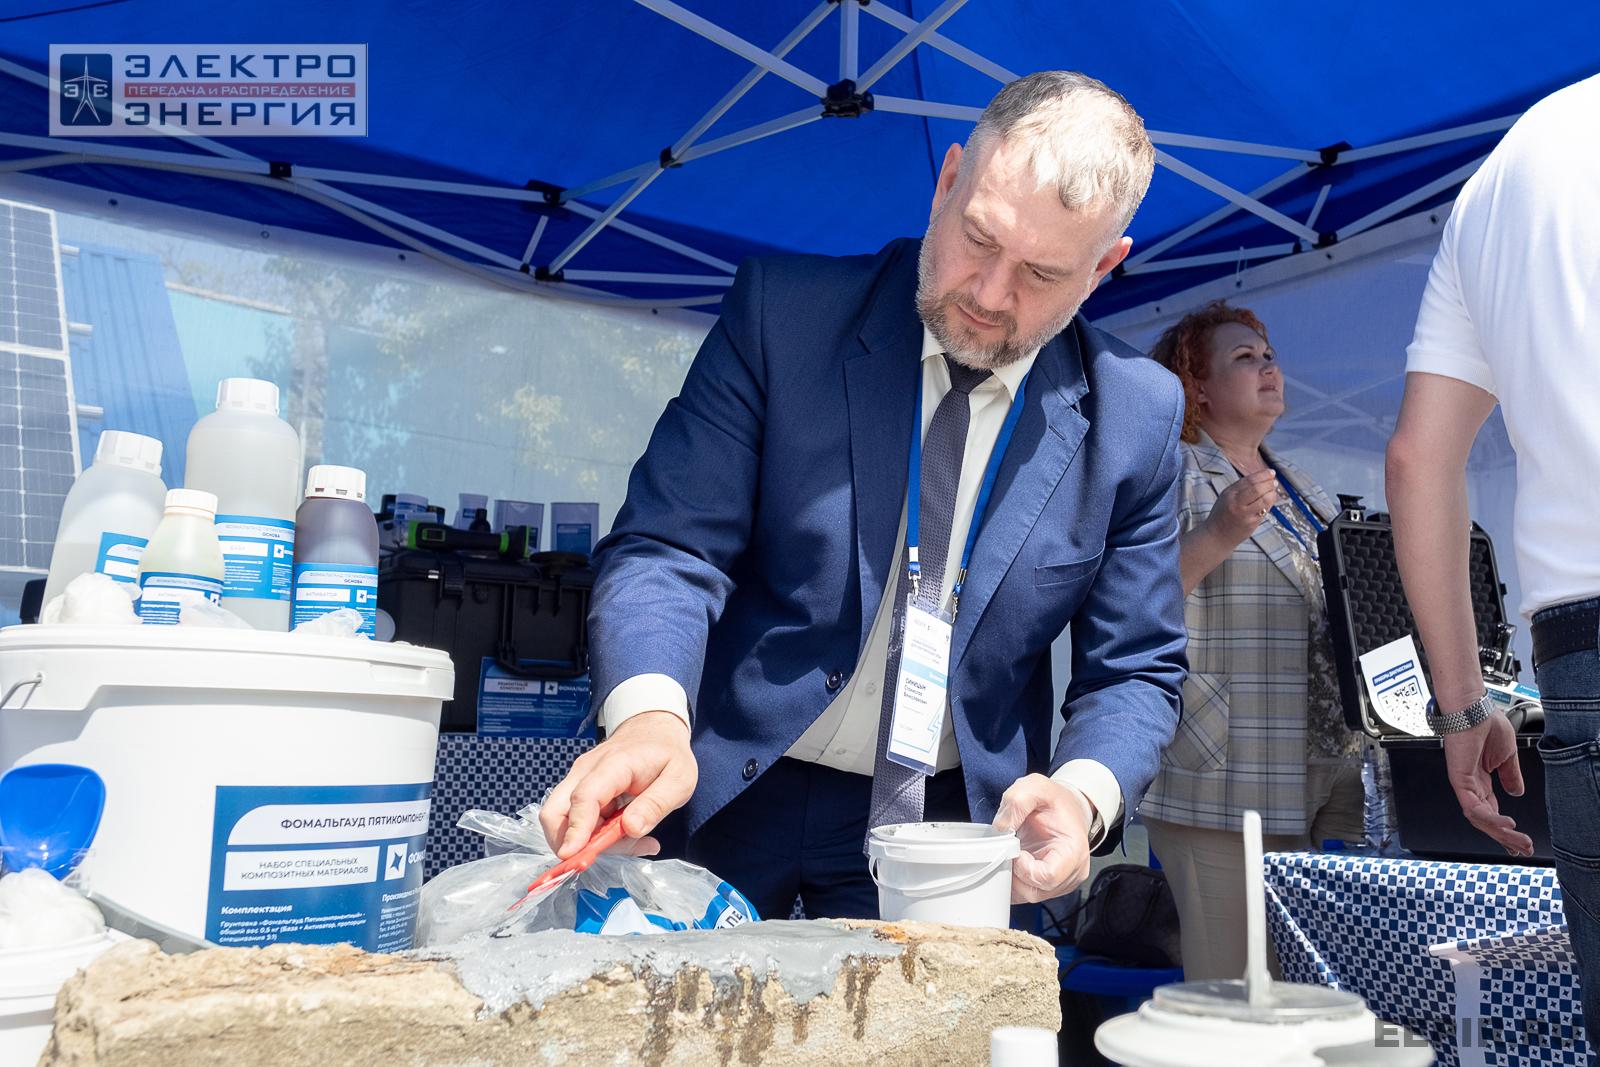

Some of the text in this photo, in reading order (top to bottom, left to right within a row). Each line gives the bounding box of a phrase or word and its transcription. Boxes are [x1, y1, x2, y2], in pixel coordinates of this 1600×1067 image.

[280, 815, 366, 830] ФОМАЛЬГАУД
[259, 856, 358, 870] НАБОР СПЕЦИАЛЬНЫХ
[240, 865, 369, 881] КОМПОЗИТНЫХ МАТЕРИАЛОВ
[221, 904, 293, 916] Комплектация
